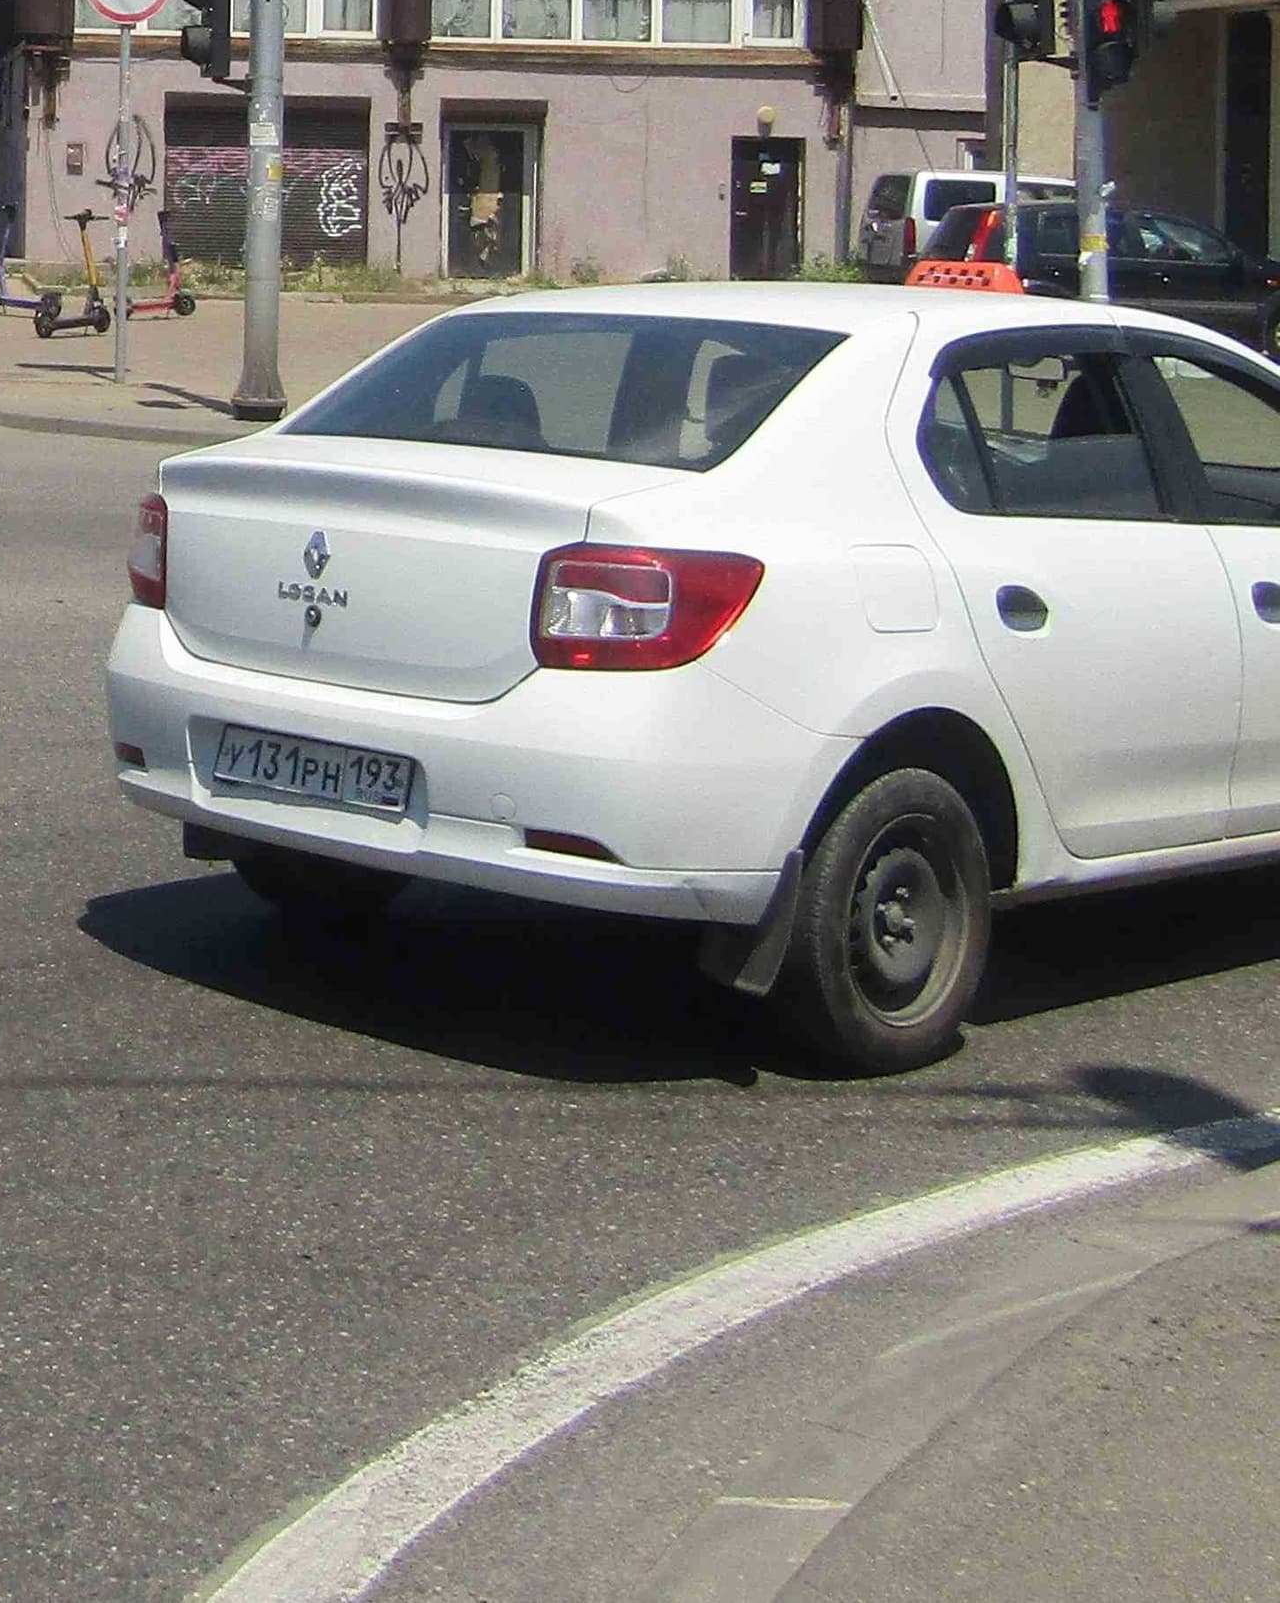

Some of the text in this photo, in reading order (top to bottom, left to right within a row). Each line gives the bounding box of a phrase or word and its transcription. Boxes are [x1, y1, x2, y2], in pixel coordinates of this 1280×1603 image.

[278, 580, 348, 608] LOGAN
[228, 739, 401, 793] У131РН 193
